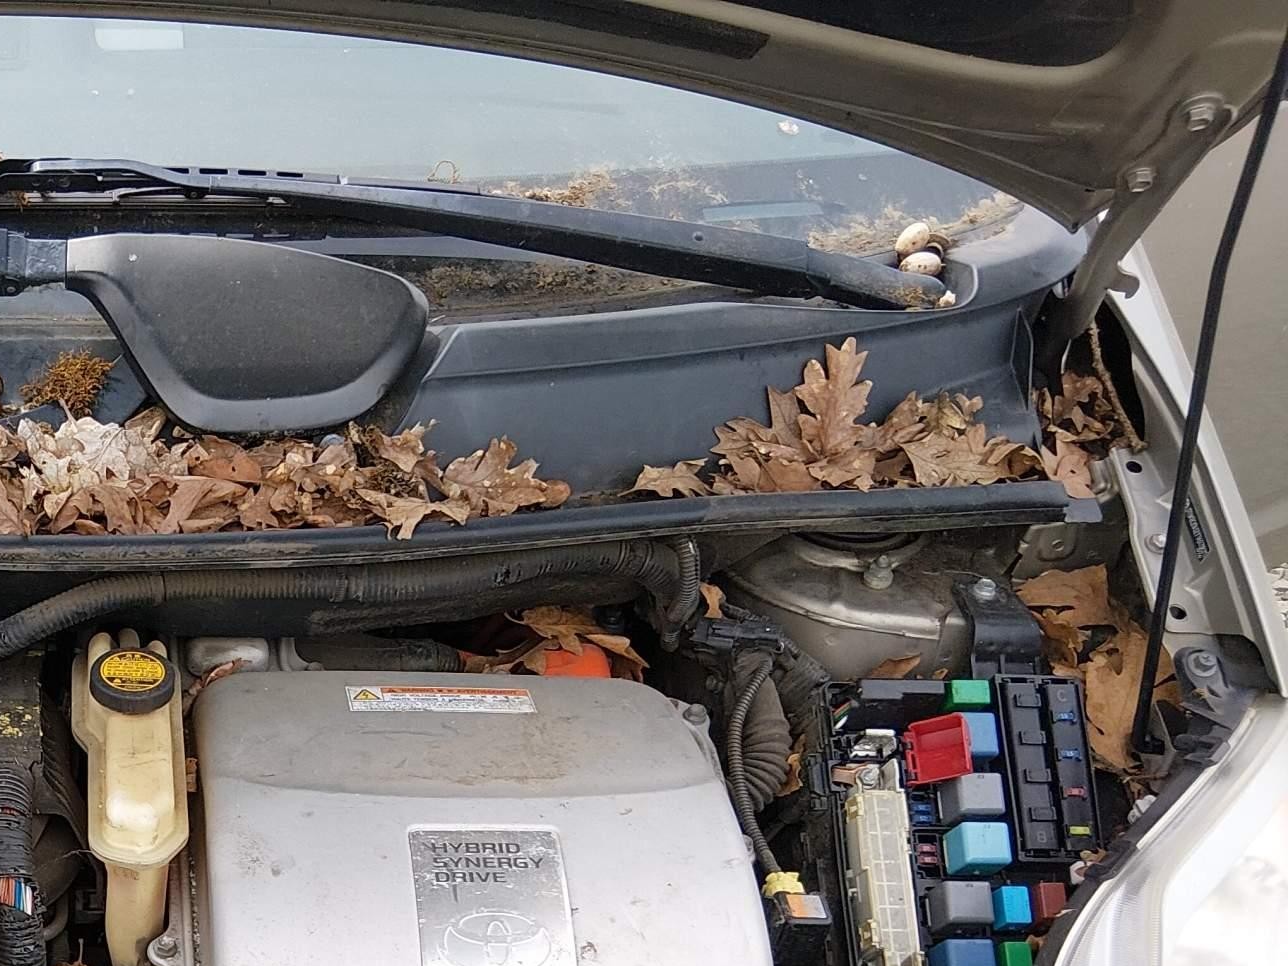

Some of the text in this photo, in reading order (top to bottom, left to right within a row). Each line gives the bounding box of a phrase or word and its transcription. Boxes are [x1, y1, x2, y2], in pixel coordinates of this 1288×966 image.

[1057, 690, 1067, 703] C
[431, 842, 521, 854] HYBRID
[432, 857, 544, 869] SYNERGY
[435, 871, 507, 883] DRIVE
